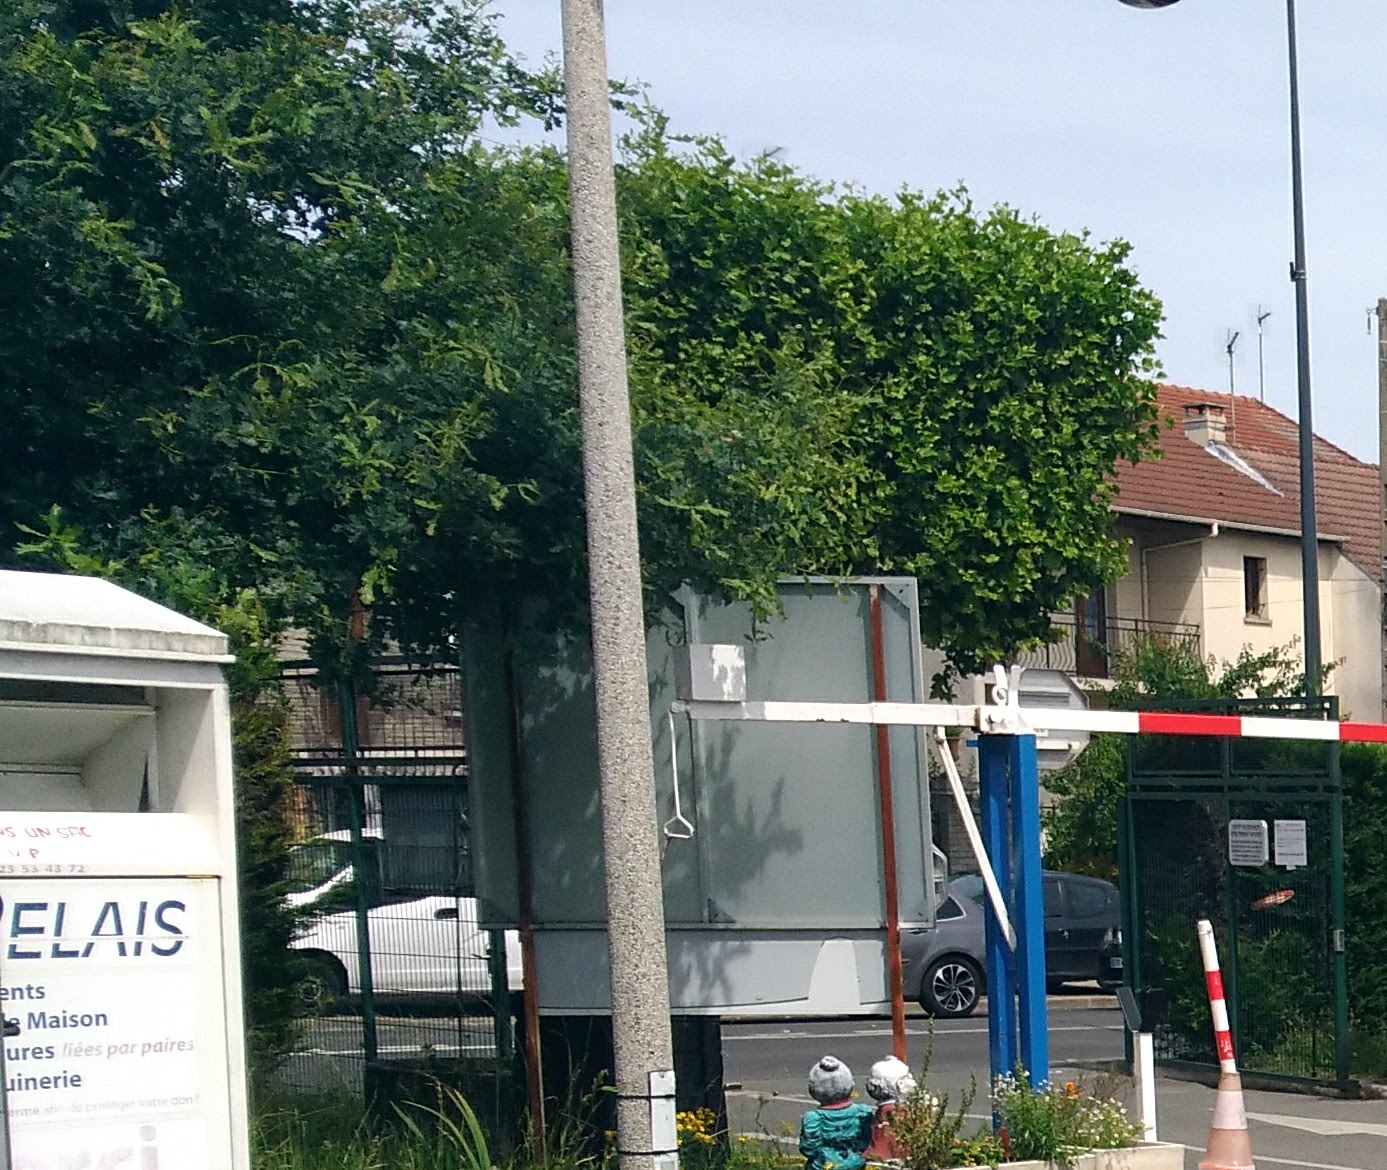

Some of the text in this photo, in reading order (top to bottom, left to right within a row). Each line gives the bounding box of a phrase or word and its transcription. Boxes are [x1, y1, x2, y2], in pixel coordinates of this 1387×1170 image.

[22, 865, 38, 873] 53
[0, 899, 187, 959] ELAIS
[27, 1010, 108, 1030] Maison
[7, 1037, 194, 1061] ures liées par paires
[171, 1095, 193, 1106] don
